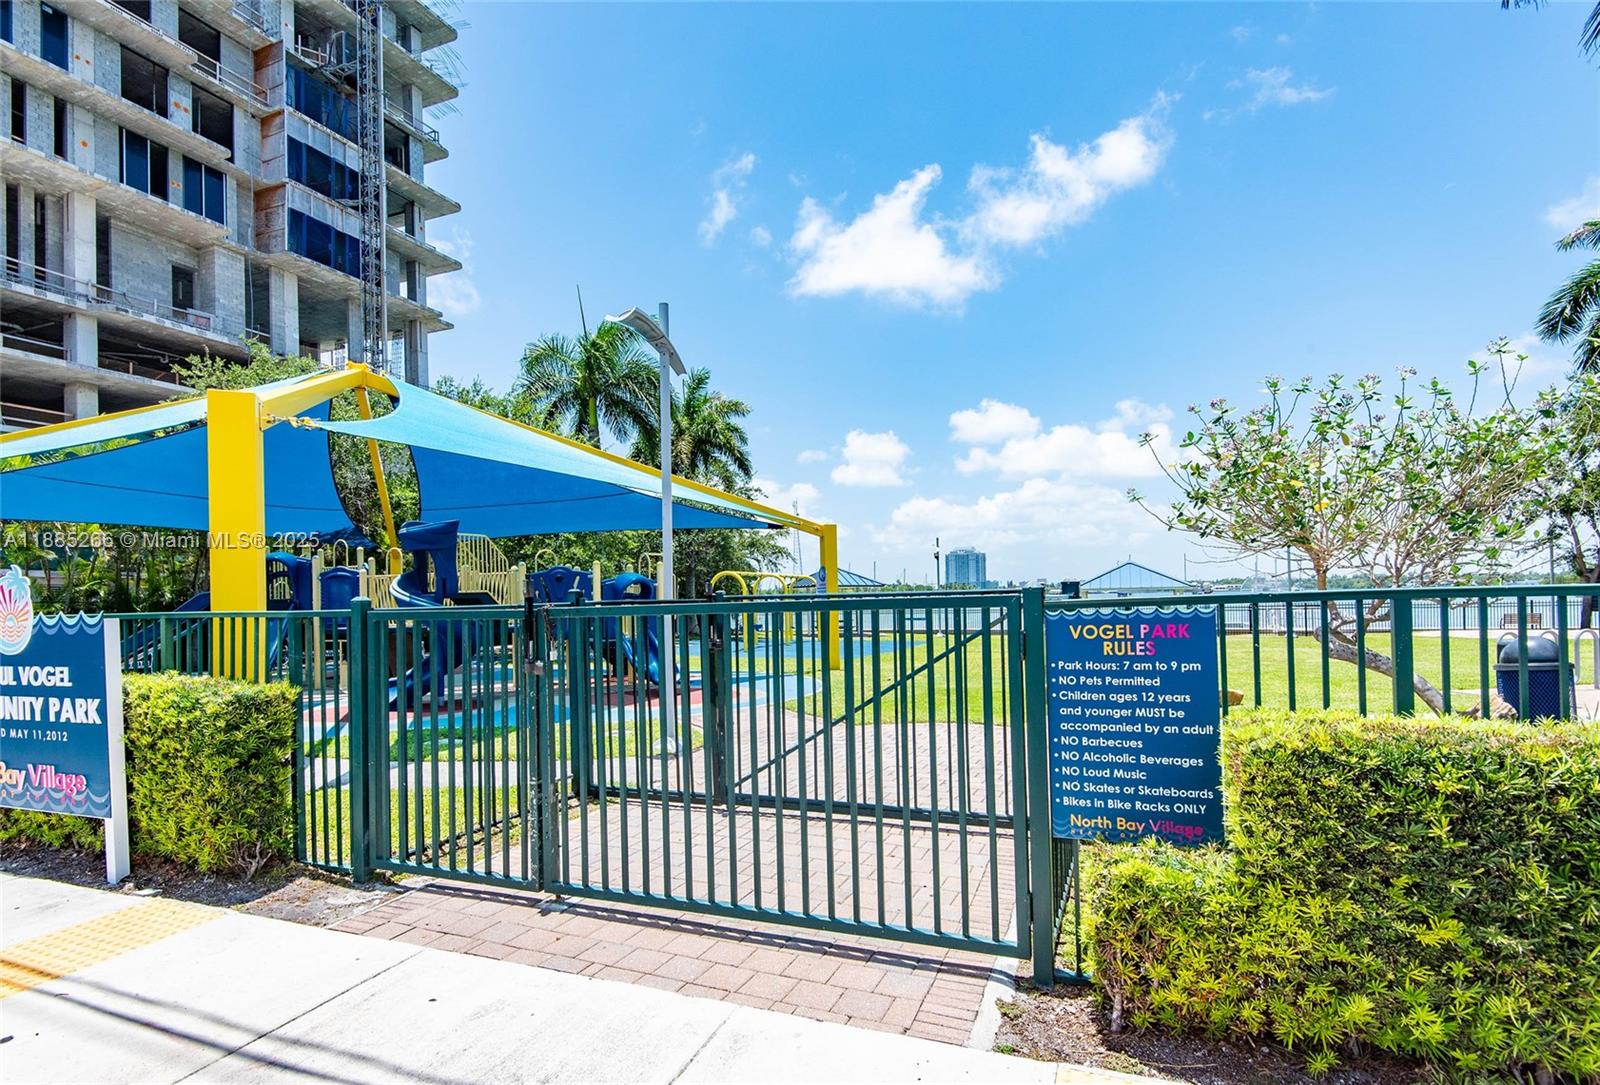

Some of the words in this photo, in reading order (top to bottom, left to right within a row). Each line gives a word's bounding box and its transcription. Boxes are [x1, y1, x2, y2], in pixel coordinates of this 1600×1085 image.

[1069, 624, 1134, 639] VOGEL
[1140, 624, 1190, 638] PARK
[1103, 641, 1156, 656] RULES
[1058, 662, 1081, 670] Park
[1085, 662, 1120, 671] Hours:
[1123, 662, 1129, 670] 7
[1133, 663, 1152, 671] am
[1155, 662, 1167, 670] to
[1171, 662, 1177, 671] 9
[1181, 664, 1201, 673] pm
[18, 665, 73, 687] VOGEL
[1059, 676, 1076, 685] NO
[1080, 677, 1103, 685] Pets
[1105, 677, 1160, 686] Permitted
[1059, 691, 1106, 701] Children
[1109, 693, 1138, 703] ages
[1142, 692, 1155, 701] 12
[1158, 694, 1191, 703] years
[48, 697, 102, 725] PARK
[1060, 706, 1082, 715] and
[1084, 708, 1131, 718] younger
[1135, 708, 1165, 717] MUST
[1169, 708, 1185, 718] be
[9, 728, 29, 739] MAY
[32, 729, 68, 742] 11,2012
[1061, 722, 1141, 733] accompanied
[1145, 724, 1160, 734] by
[1163, 725, 1179, 733] an
[1182, 725, 1213, 734] adult
[1061, 736, 1079, 745] NO
[1082, 737, 1143, 748] Barbecues
[1061, 751, 1079, 760] NO
[1083, 752, 1136, 763] Alcoholic
[1140, 755, 1204, 768] Beverages
[1062, 766, 1080, 775] NO
[1083, 767, 1110, 777] Loud
[1114, 769, 1147, 779] Music
[27, 763, 87, 798] Village
[1062, 782, 1080, 791] NO
[1083, 782, 1120, 793] Skates
[1123, 786, 1135, 794] or
[1138, 785, 1213, 798] Skateboards
[1063, 796, 1091, 807] Bikes
[1094, 798, 1104, 808] in
[1108, 797, 1132, 810] Bike
[1136, 801, 1170, 812] Racks
[1174, 803, 1207, 814] ONLY
[1070, 814, 1112, 828] North
[1117, 817, 1145, 832] Bay
[1149, 819, 1204, 838] Village
